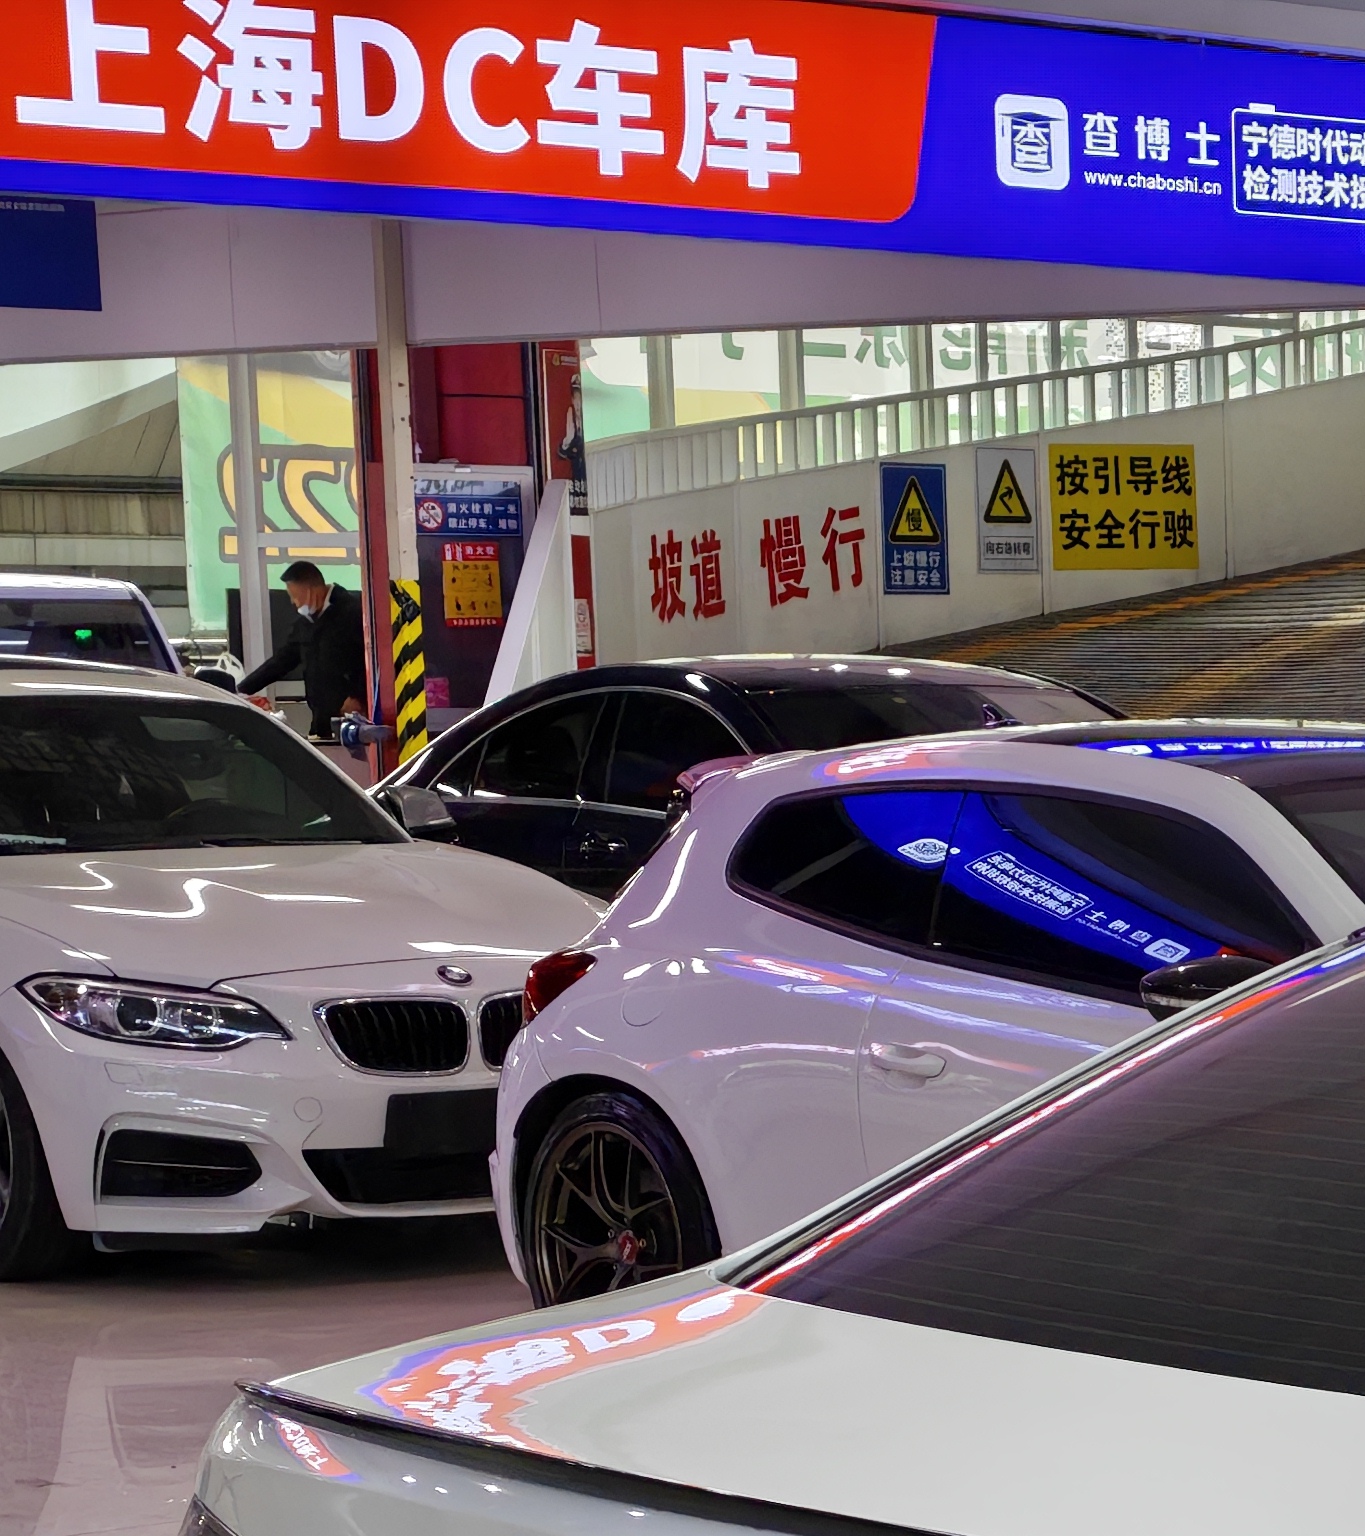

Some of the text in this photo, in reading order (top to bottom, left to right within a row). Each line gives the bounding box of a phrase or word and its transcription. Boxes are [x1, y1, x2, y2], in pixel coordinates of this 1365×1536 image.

[14, 0, 802, 189] 上海DC车库
[1082, 111, 1221, 166] 查博士
[1084, 171, 1222, 195] www.chaboshi.cn
[1055, 454, 1194, 498] 按引导线
[905, 508, 923, 532] 慢
[1058, 508, 1196, 553] 安全行驶
[648, 505, 866, 624] 坡道 慢行
[890, 550, 941, 568] 上坡慢行
[891, 569, 941, 586] 注意安全
